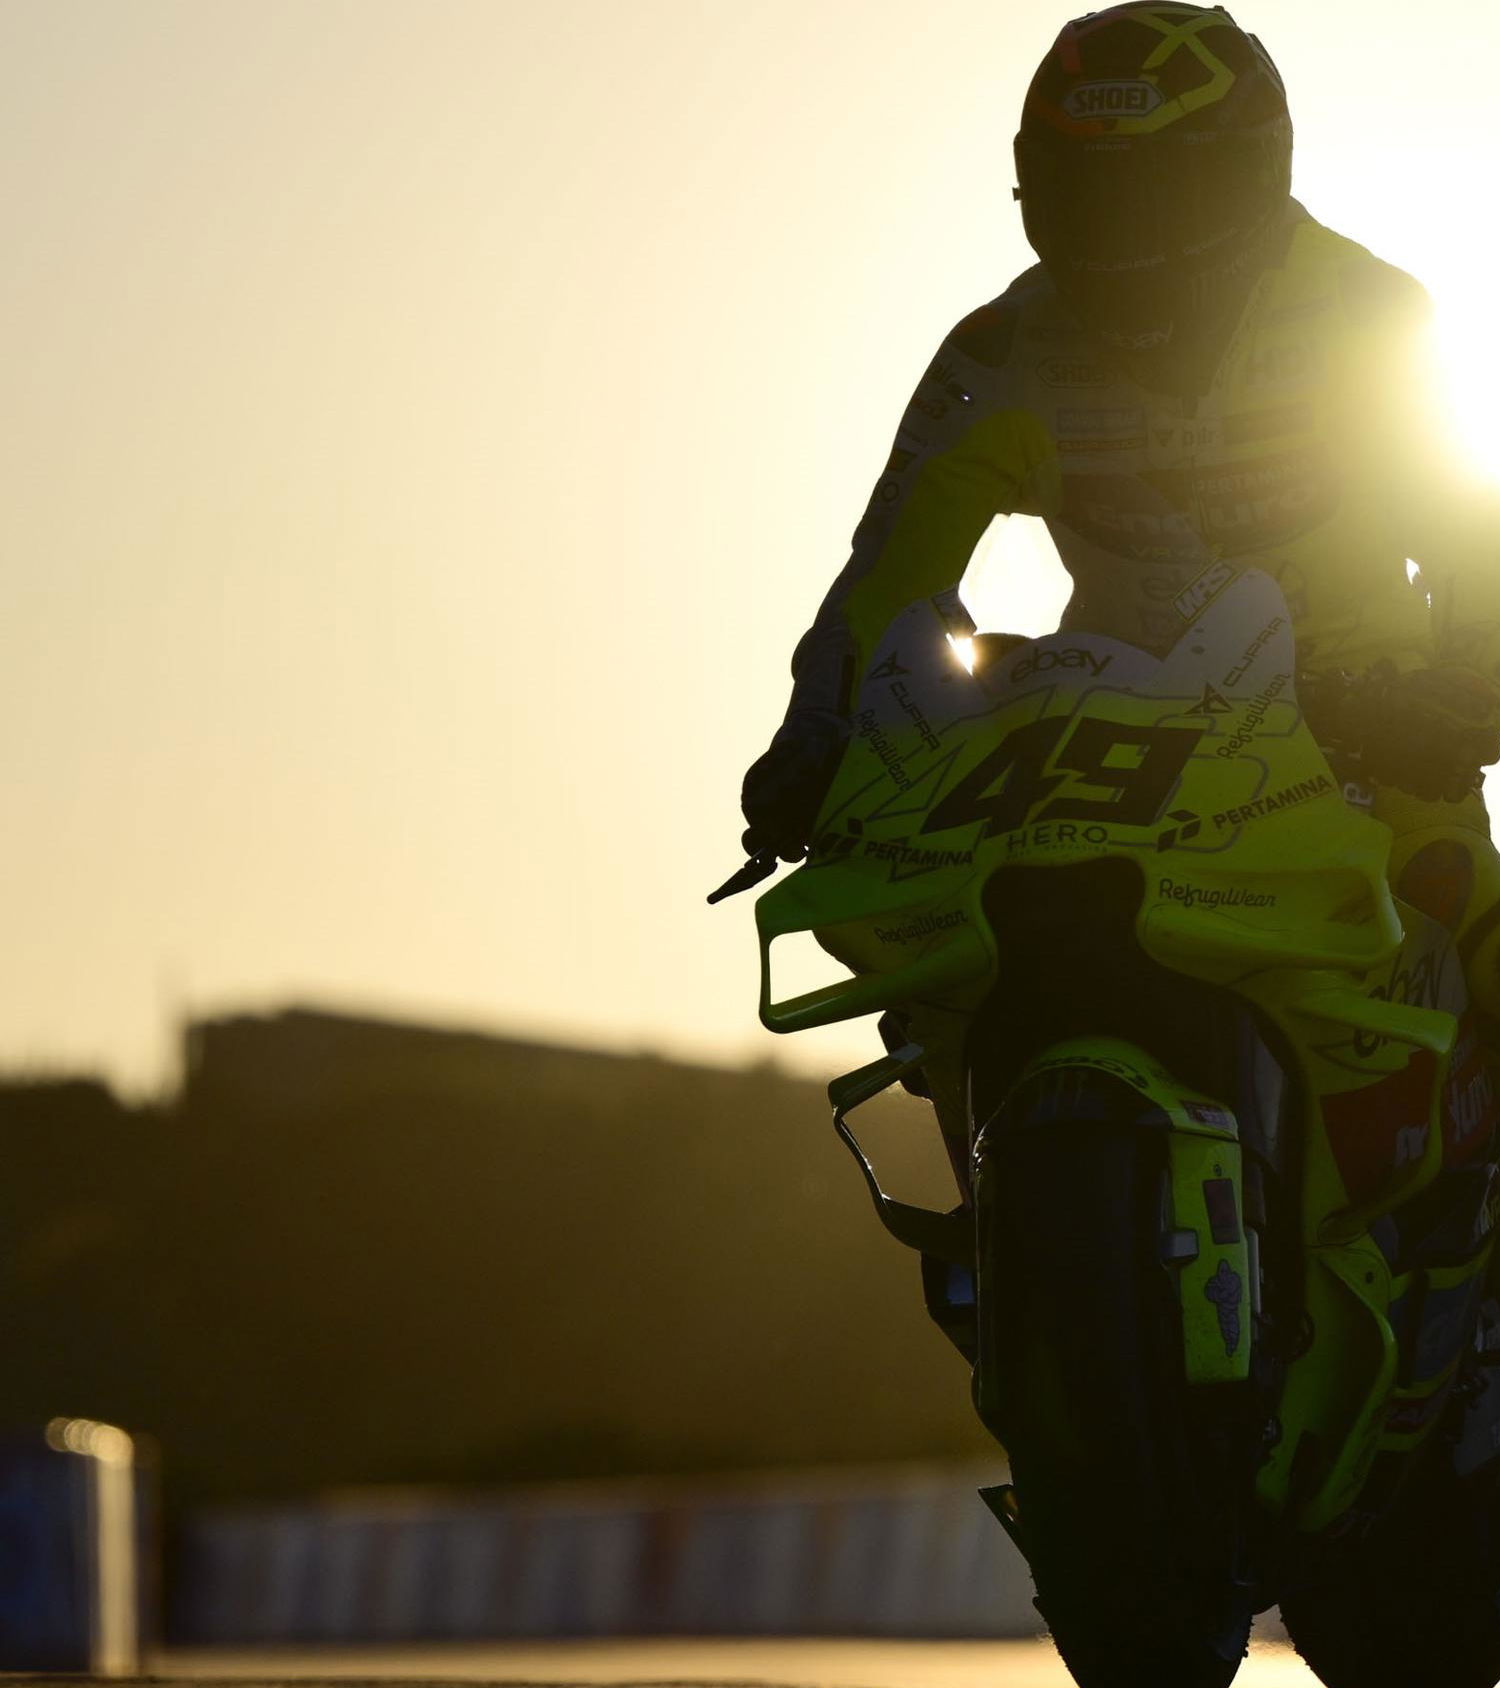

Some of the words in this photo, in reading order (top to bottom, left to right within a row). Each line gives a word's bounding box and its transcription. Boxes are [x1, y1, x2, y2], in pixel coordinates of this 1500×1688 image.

[1072, 87, 1149, 113] SHOEI
[1010, 648, 1112, 683] ebay
[920, 716, 1205, 838] 49
[1212, 775, 1332, 829] PERTAMINA
[864, 841, 973, 865] PERTAMINA
[1007, 824, 1108, 851] HERO
